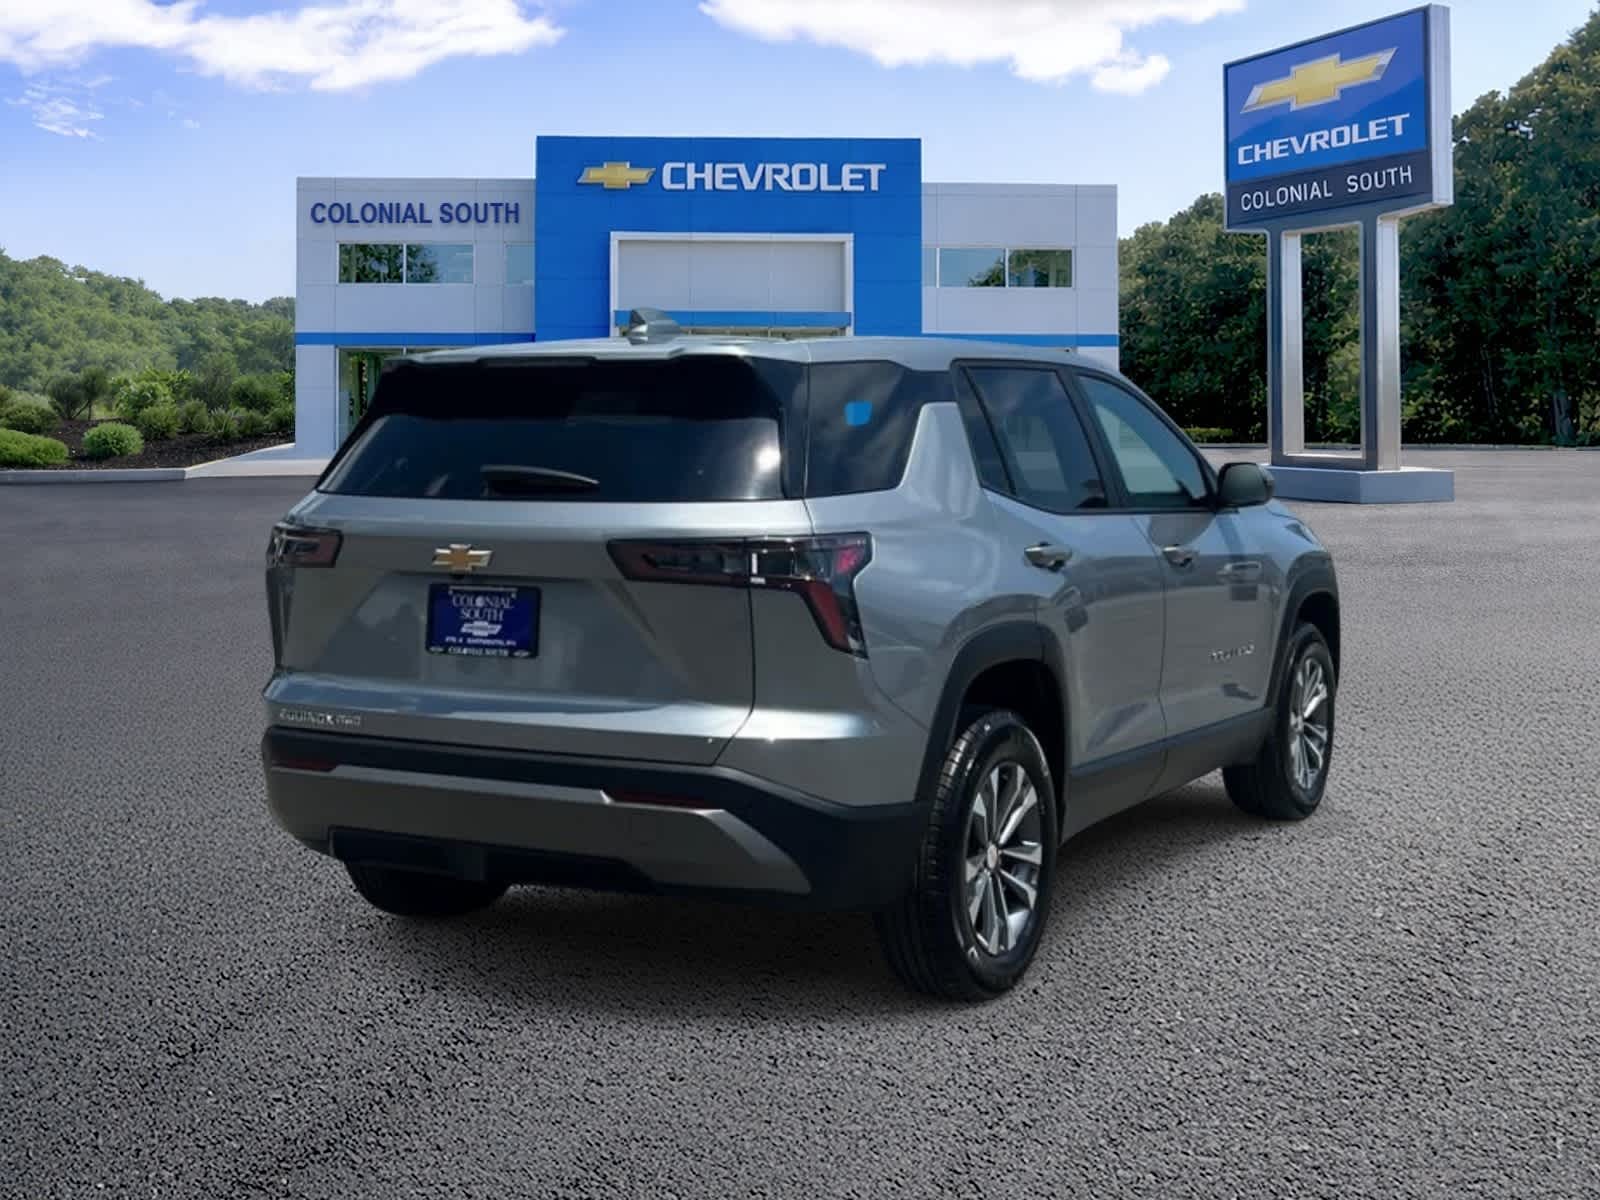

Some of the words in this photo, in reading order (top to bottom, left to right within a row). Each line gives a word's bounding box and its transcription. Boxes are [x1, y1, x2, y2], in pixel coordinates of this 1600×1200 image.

[1237, 113, 1410, 165] CHEVROLET
[661, 161, 887, 192] CHEVROLET
[1240, 179, 1333, 212] COLONIAL
[1346, 165, 1413, 194] SOUTH
[310, 202, 432, 224] COLONIAL
[439, 202, 520, 224] SOUTH
[452, 595, 514, 609] COLONIAL
[460, 608, 504, 621] SOUTH
